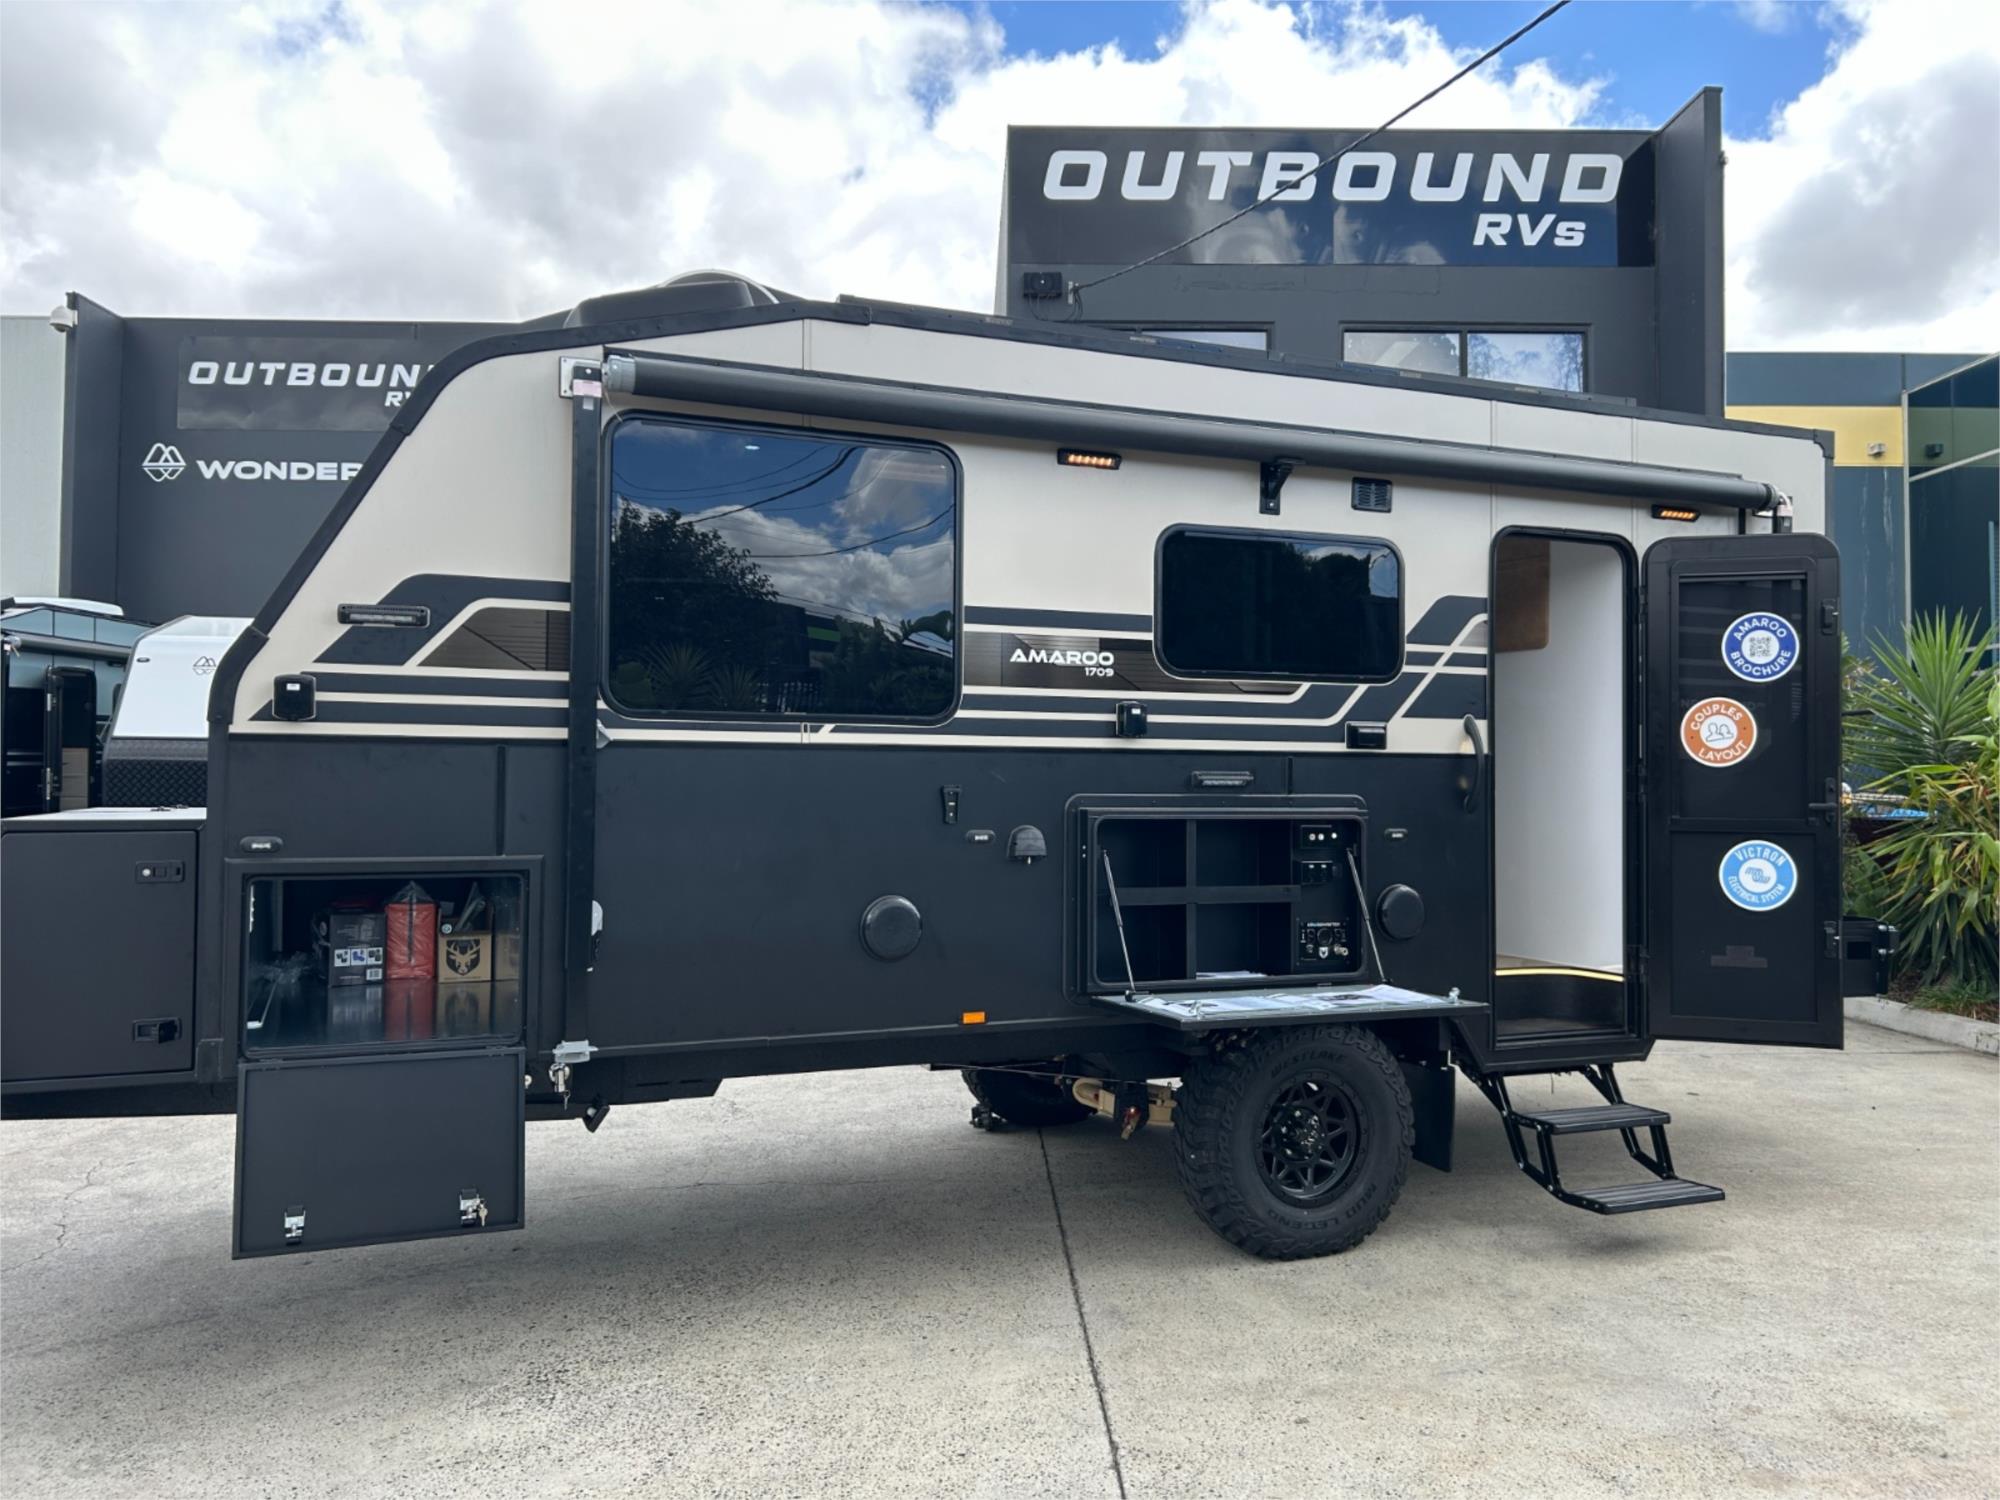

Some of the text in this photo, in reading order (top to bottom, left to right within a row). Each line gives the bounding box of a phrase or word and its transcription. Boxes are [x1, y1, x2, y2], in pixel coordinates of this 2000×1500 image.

[1043, 149, 1624, 203] OUTBOUND
[1472, 213, 1587, 247] RVs
[188, 361, 435, 388] OUTBOUN
[1733, 617, 1788, 641] AMAROO
[1009, 648, 1115, 667] AMAROO
[1730, 649, 1792, 676] BROCHURE
[1084, 667, 1115, 677] 1709
[1690, 703, 1743, 731] COUPLES
[1698, 739, 1748, 761] LAYOUT
[1734, 846, 1787, 867] VICTRON
